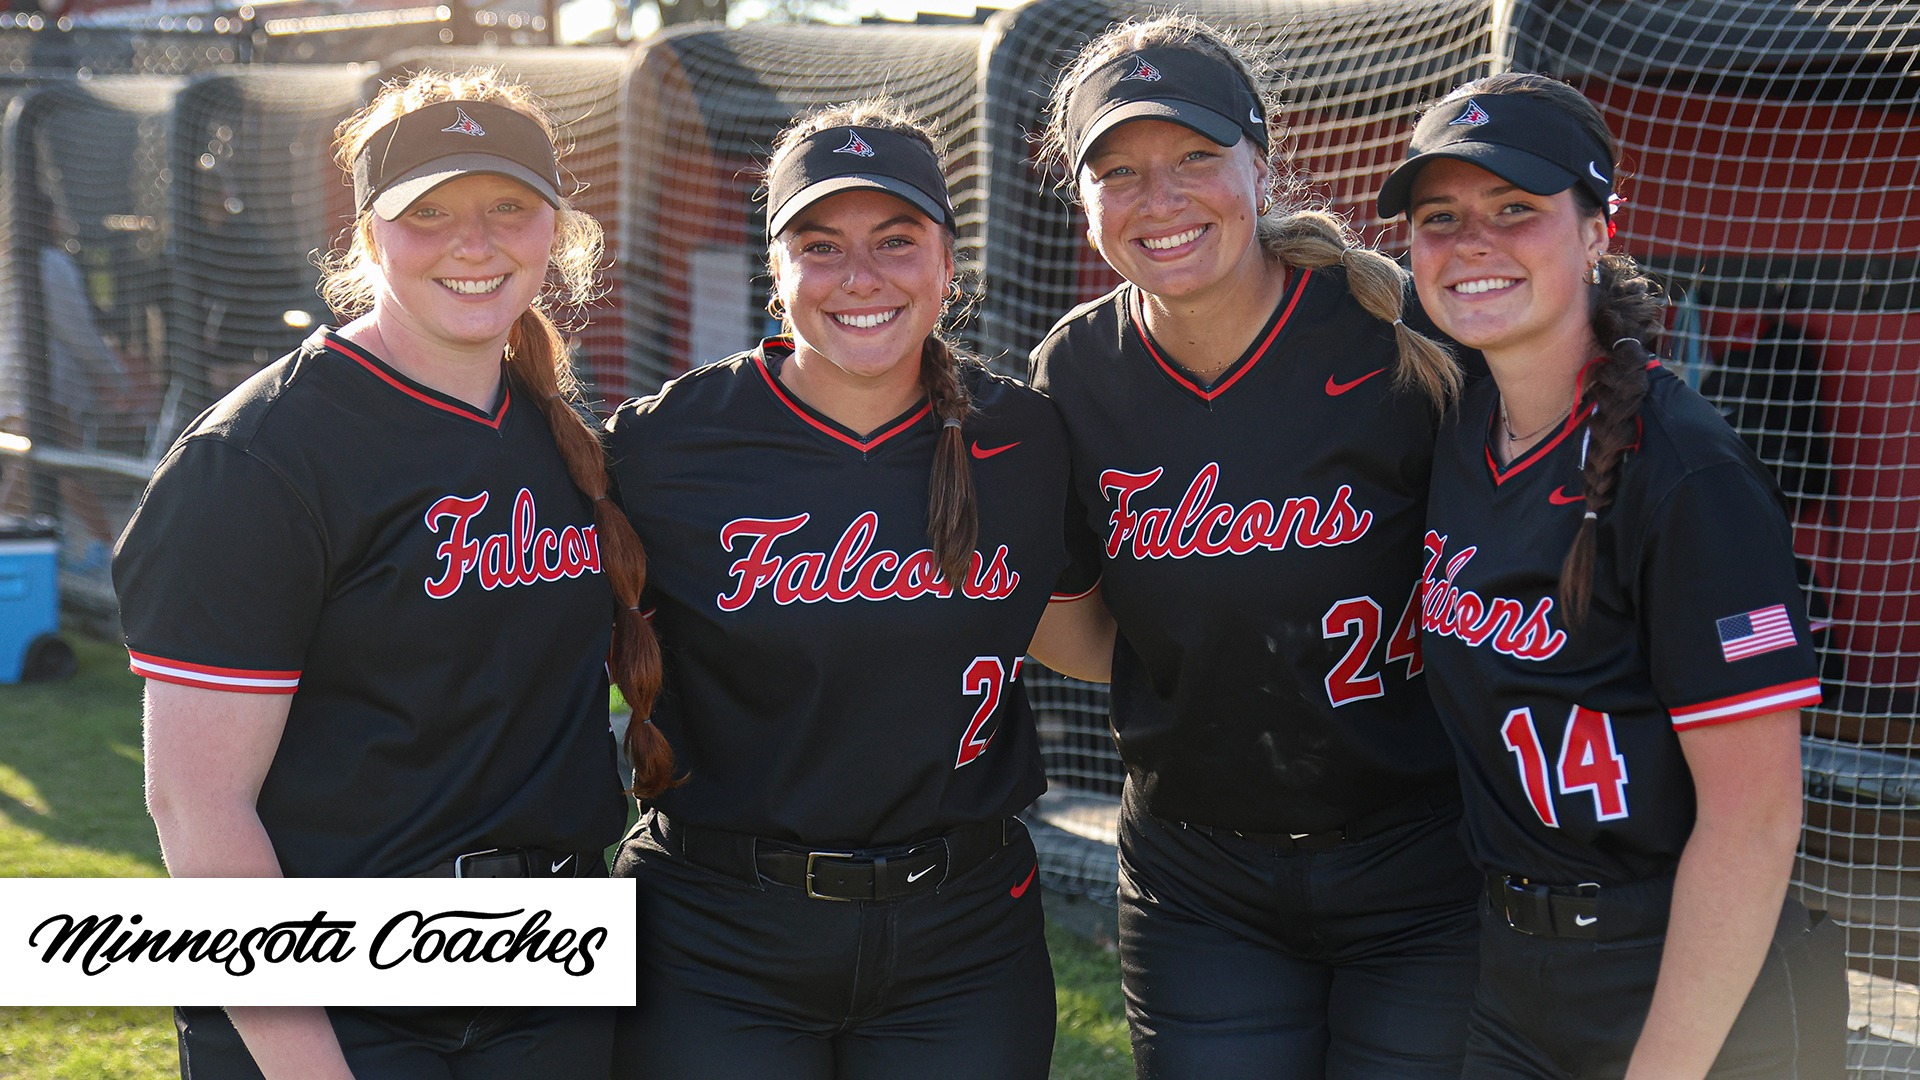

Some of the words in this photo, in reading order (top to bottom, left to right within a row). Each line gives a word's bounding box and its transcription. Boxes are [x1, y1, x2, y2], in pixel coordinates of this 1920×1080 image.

[425, 488, 605, 599] Falcon
[717, 511, 1020, 611] Falcons
[1100, 462, 1373, 560] Falcons
[1321, 578, 1424, 709] 24
[954, 656, 1024, 769] 2
[1501, 704, 1629, 828] 14
